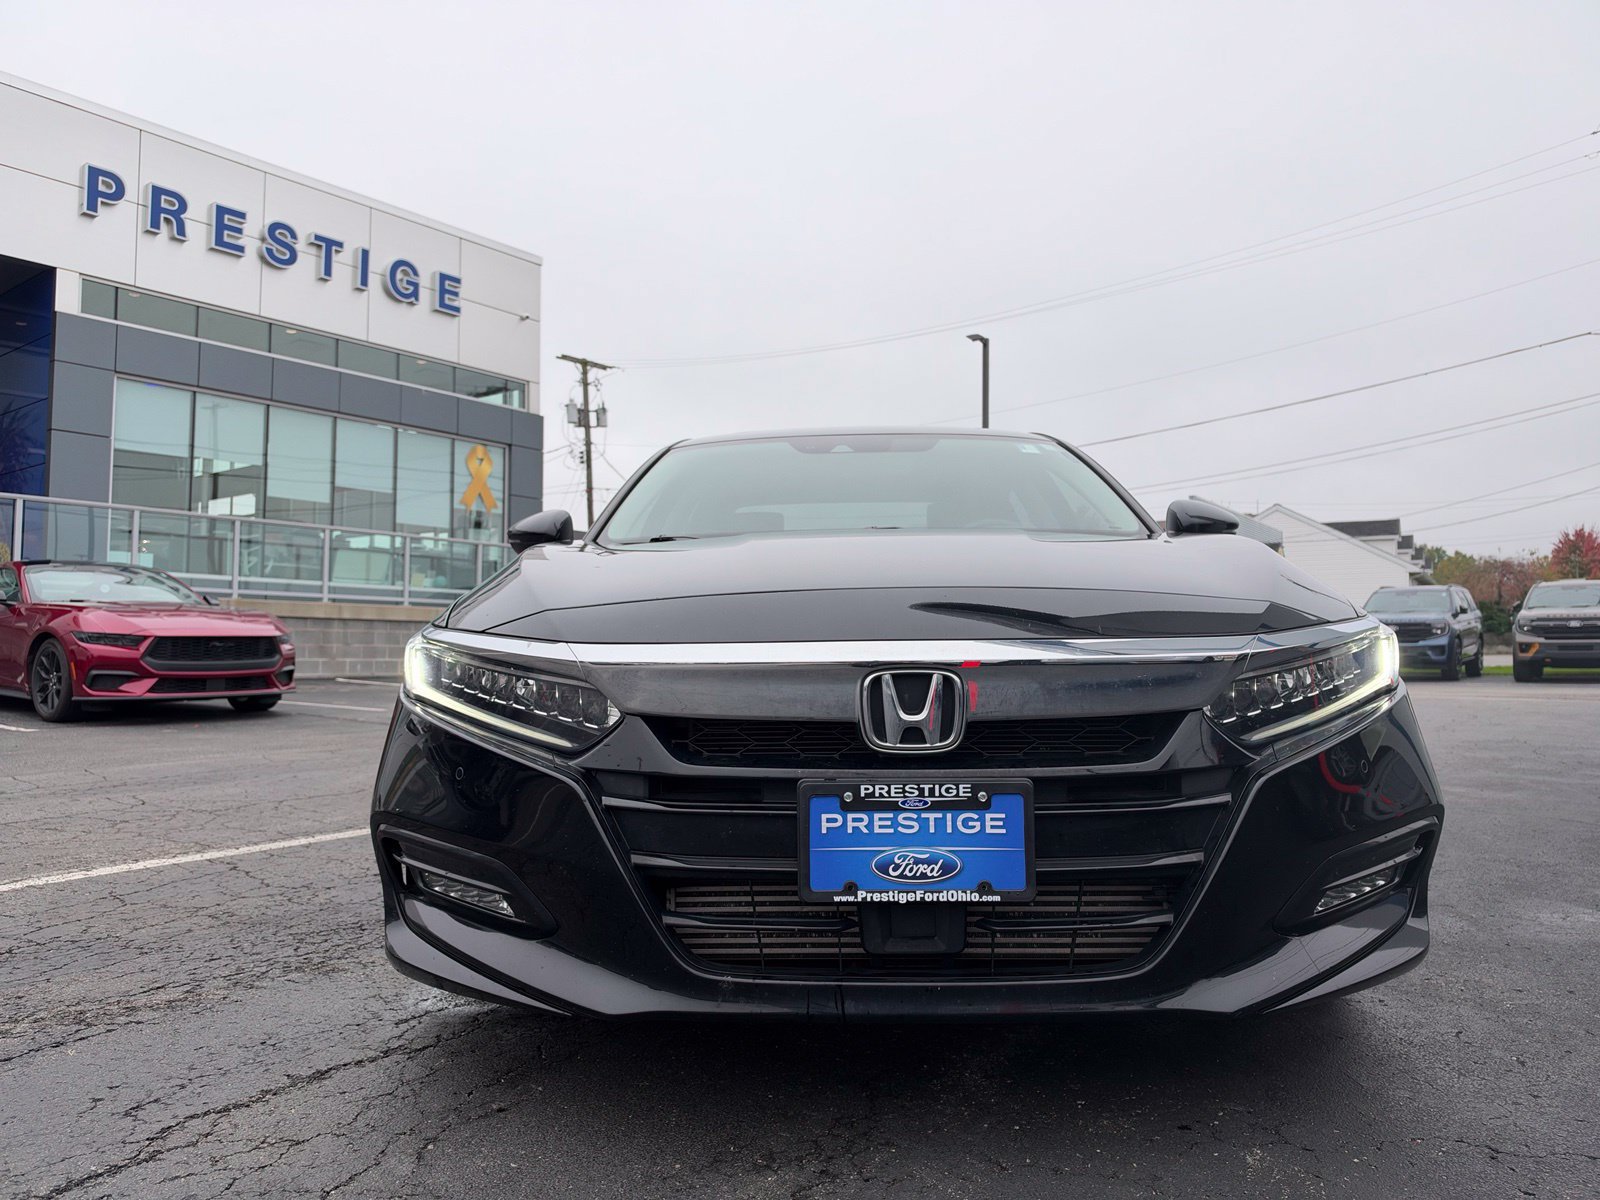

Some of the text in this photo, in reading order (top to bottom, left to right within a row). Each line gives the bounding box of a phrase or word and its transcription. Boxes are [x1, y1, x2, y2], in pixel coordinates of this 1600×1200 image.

[80, 162, 462, 316] PRESTIGE
[860, 784, 972, 797] PRESTIGE
[904, 799, 925, 807] Ford
[820, 812, 1007, 834] PRESTIGE
[888, 851, 944, 877] Ford
[833, 890, 1001, 904] www.PrestigeFordOhio.com
